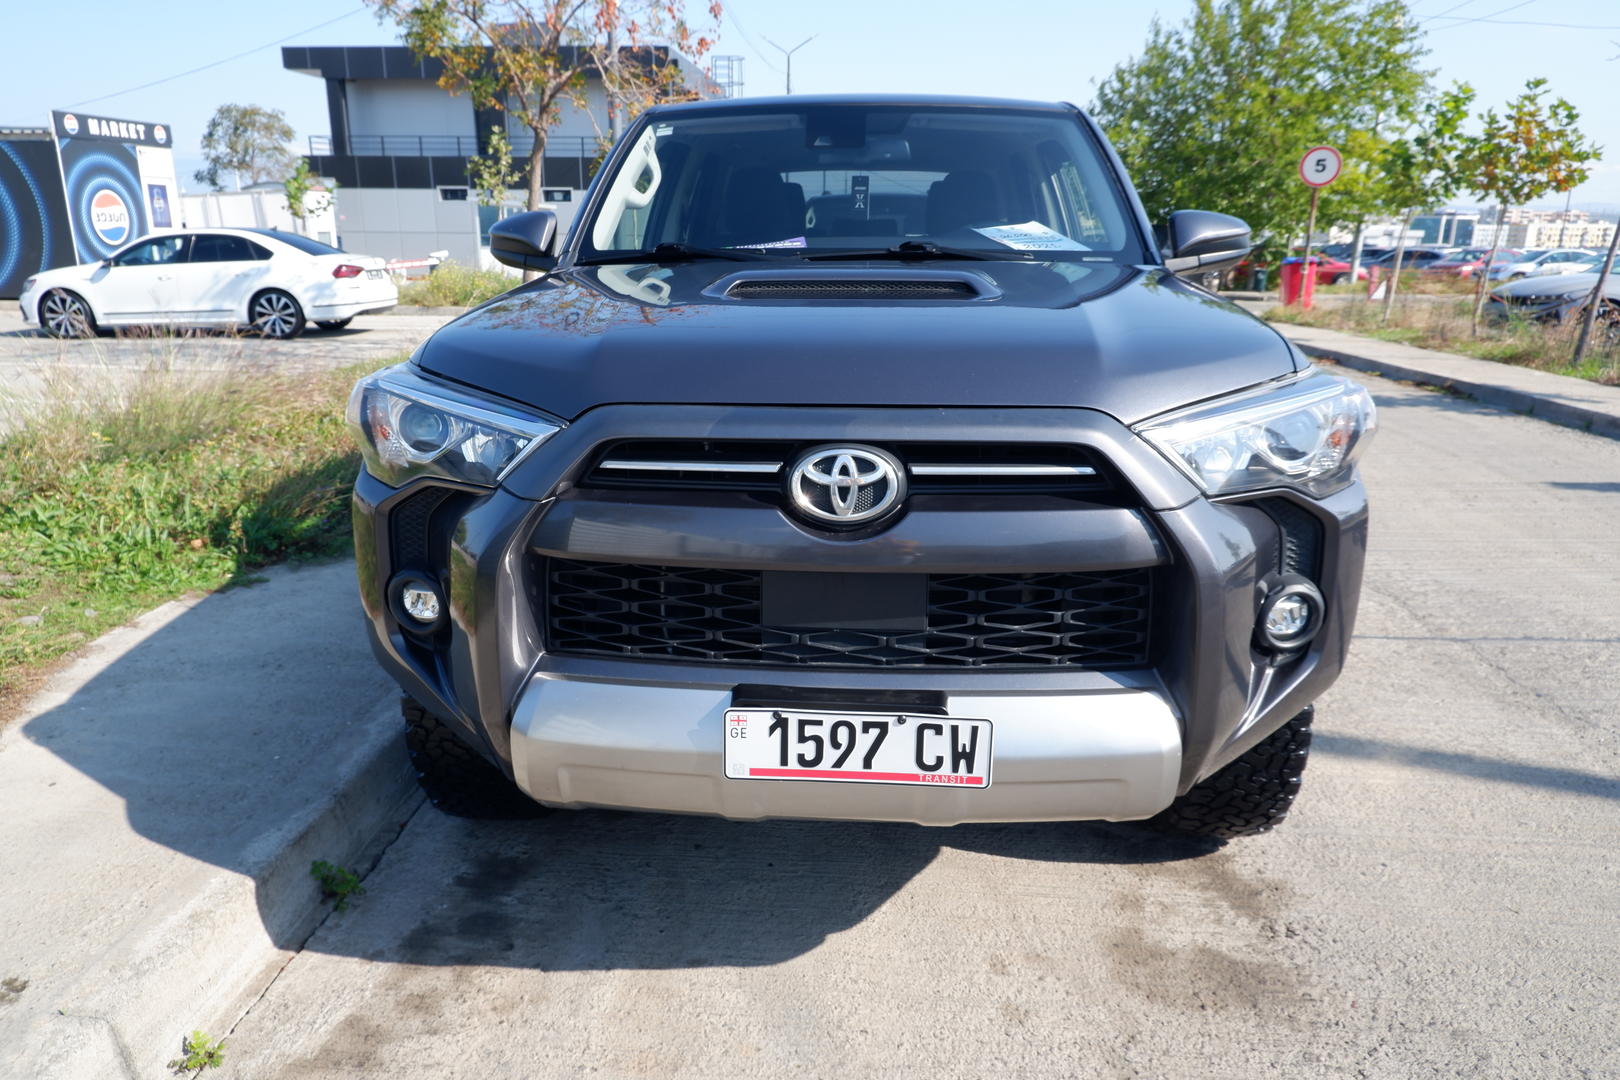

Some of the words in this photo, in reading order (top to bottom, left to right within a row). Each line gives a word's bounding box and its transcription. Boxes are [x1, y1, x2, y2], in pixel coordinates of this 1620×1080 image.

[88, 118, 145, 140] MARKET
[1314, 158, 1327, 173] 5
[730, 727, 747, 739] GE
[768, 715, 889, 770] 1597
[915, 722, 979, 774] CW
[918, 774, 968, 784] TRANSIT
